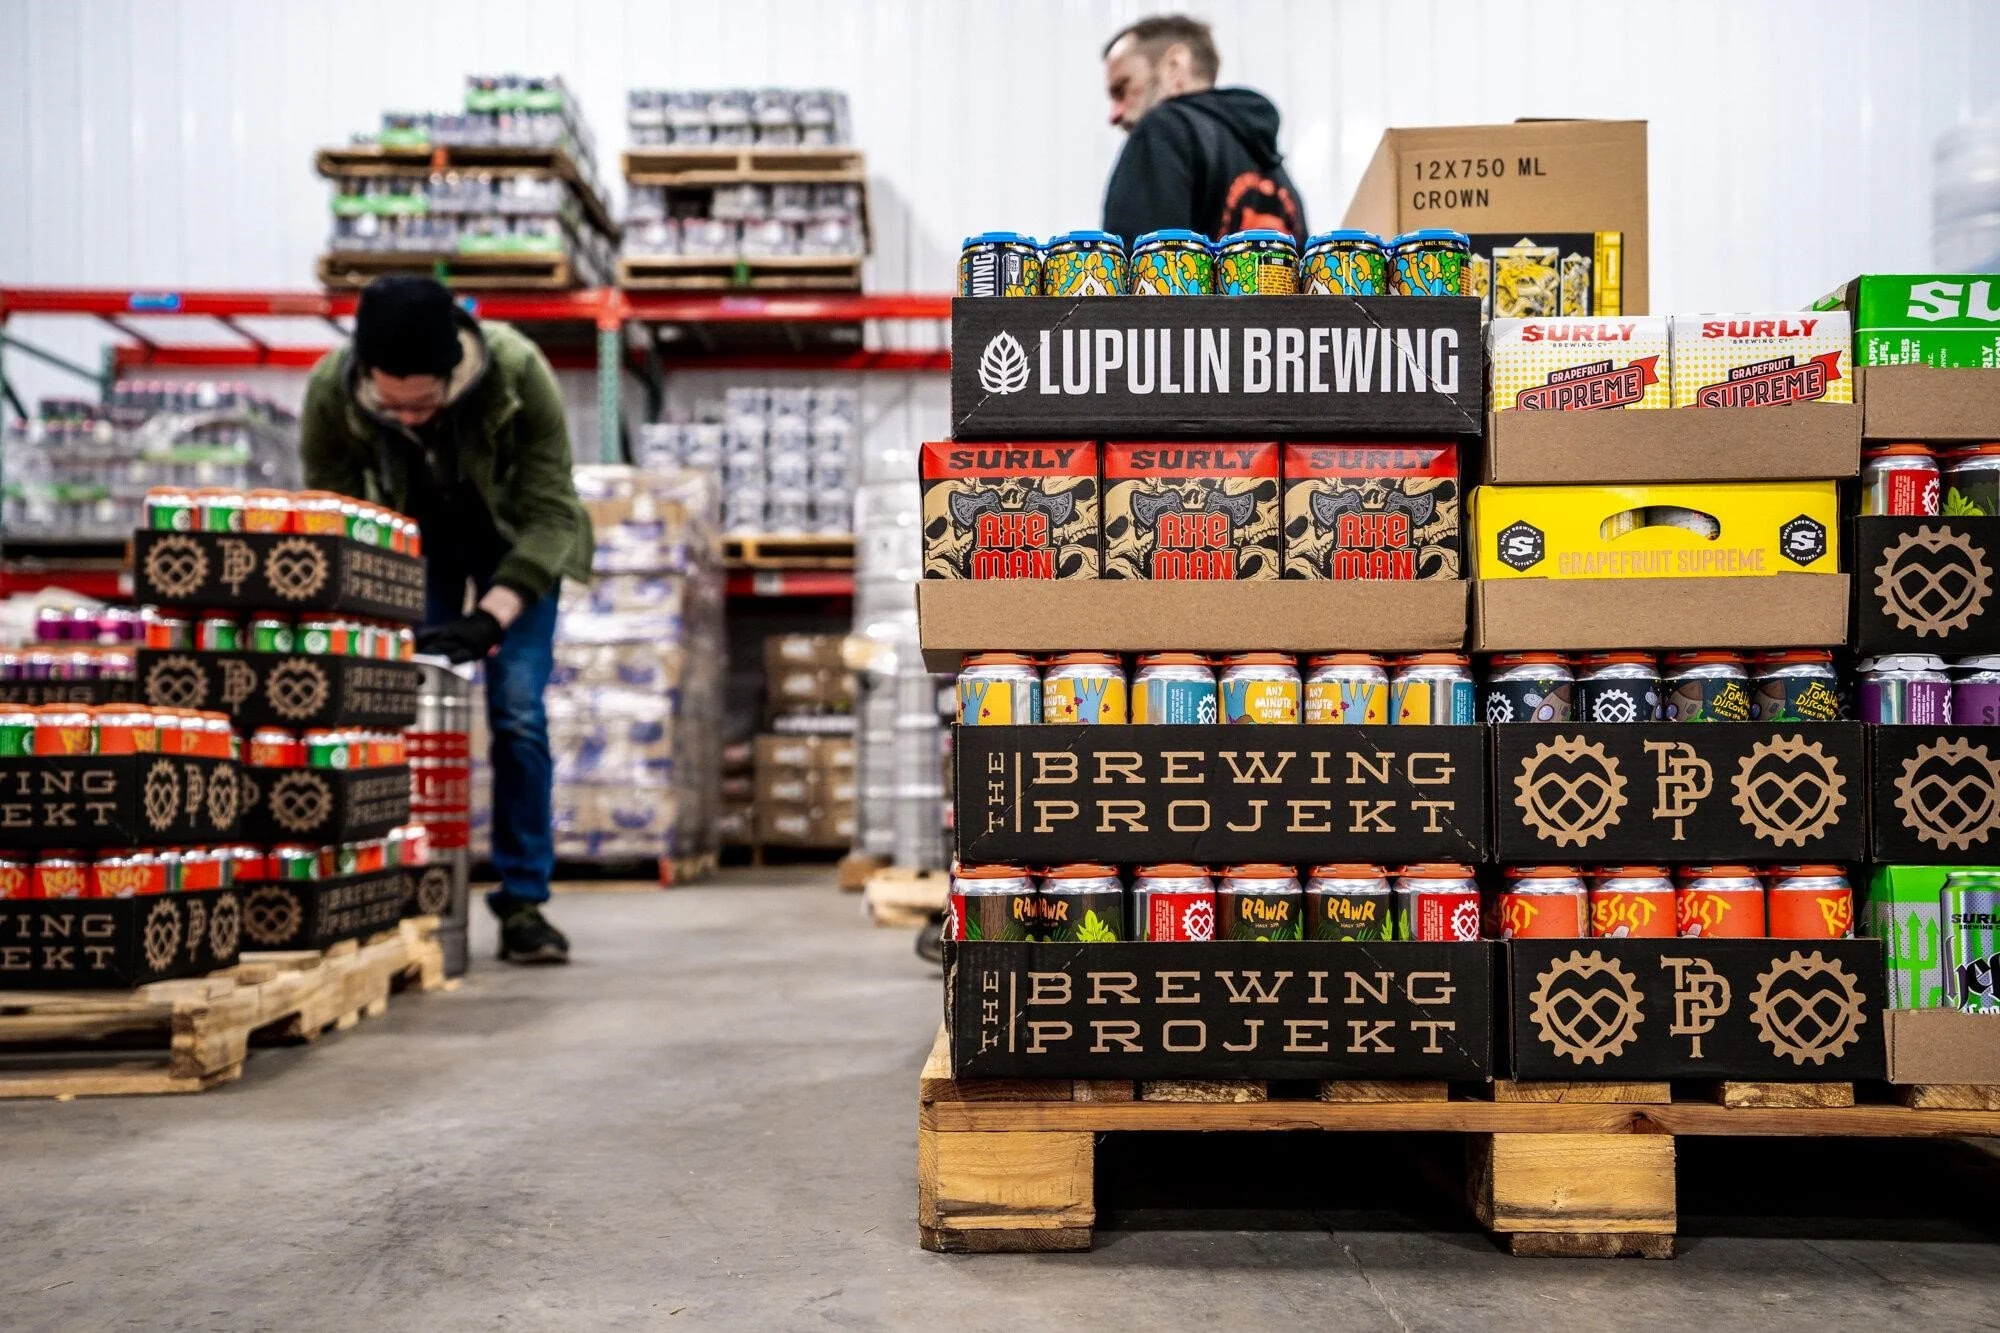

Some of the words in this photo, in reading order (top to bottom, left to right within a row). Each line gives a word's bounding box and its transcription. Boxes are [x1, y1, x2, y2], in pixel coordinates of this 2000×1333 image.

[1415, 158, 1504, 180] 12X750
[1518, 157, 1546, 176] ML
[1413, 189, 1489, 210] CROWN
[1522, 323, 1637, 342] SURLY
[1702, 319, 1819, 338] SURLY
[1039, 329, 1229, 395] LUPULIN
[1243, 328, 1459, 394] BREWING
[1551, 362, 1609, 383] GRAPEFRUIT
[1732, 358, 1791, 380] GRAPEFRUIT
[1523, 373, 1638, 410] SUPREME
[1704, 368, 1820, 407] SUPREME
[948, 448, 1074, 470] SURLY
[1130, 449, 1260, 470] SURLY
[1310, 449, 1434, 470] SURLY
[977, 510, 1048, 549] AXE
[1157, 510, 1230, 549] AXE
[1336, 511, 1410, 549] AXE
[1511, 525, 1537, 535] BREWING
[1794, 520, 1819, 530] BREWING
[1501, 551, 1513, 564] TWIN
[1559, 550, 1672, 575] GRAPEFRUIT
[1677, 548, 1767, 573] SUPREME
[1784, 545, 1796, 559] TWIN
[971, 549, 1057, 580] MAN
[1152, 549, 1237, 580] MAN
[1332, 549, 1418, 580] MAN
[1045, 683, 1058, 694] ANY
[1265, 685, 1284, 696] ANY
[1309, 687, 1323, 698] ANY
[1254, 697, 1292, 709] MINUTE
[1715, 707, 1733, 718] HAZY
[1797, 707, 1816, 718] HAZY
[1816, 712, 1826, 720] IPA
[1032, 751, 1457, 785] BREWING
[0, 771, 118, 796] ING
[988, 752, 1004, 833] THE
[1033, 799, 1456, 833] PROJEKT
[1039, 897, 1069, 921] AWR
[1241, 897, 1289, 923] RAWR
[1327, 897, 1376, 923] RAWR
[0, 914, 116, 938] ING
[1027, 970, 1457, 1005] BREWING
[982, 971, 999, 1048] THE
[1026, 1020, 1457, 1055] PROJEKT
